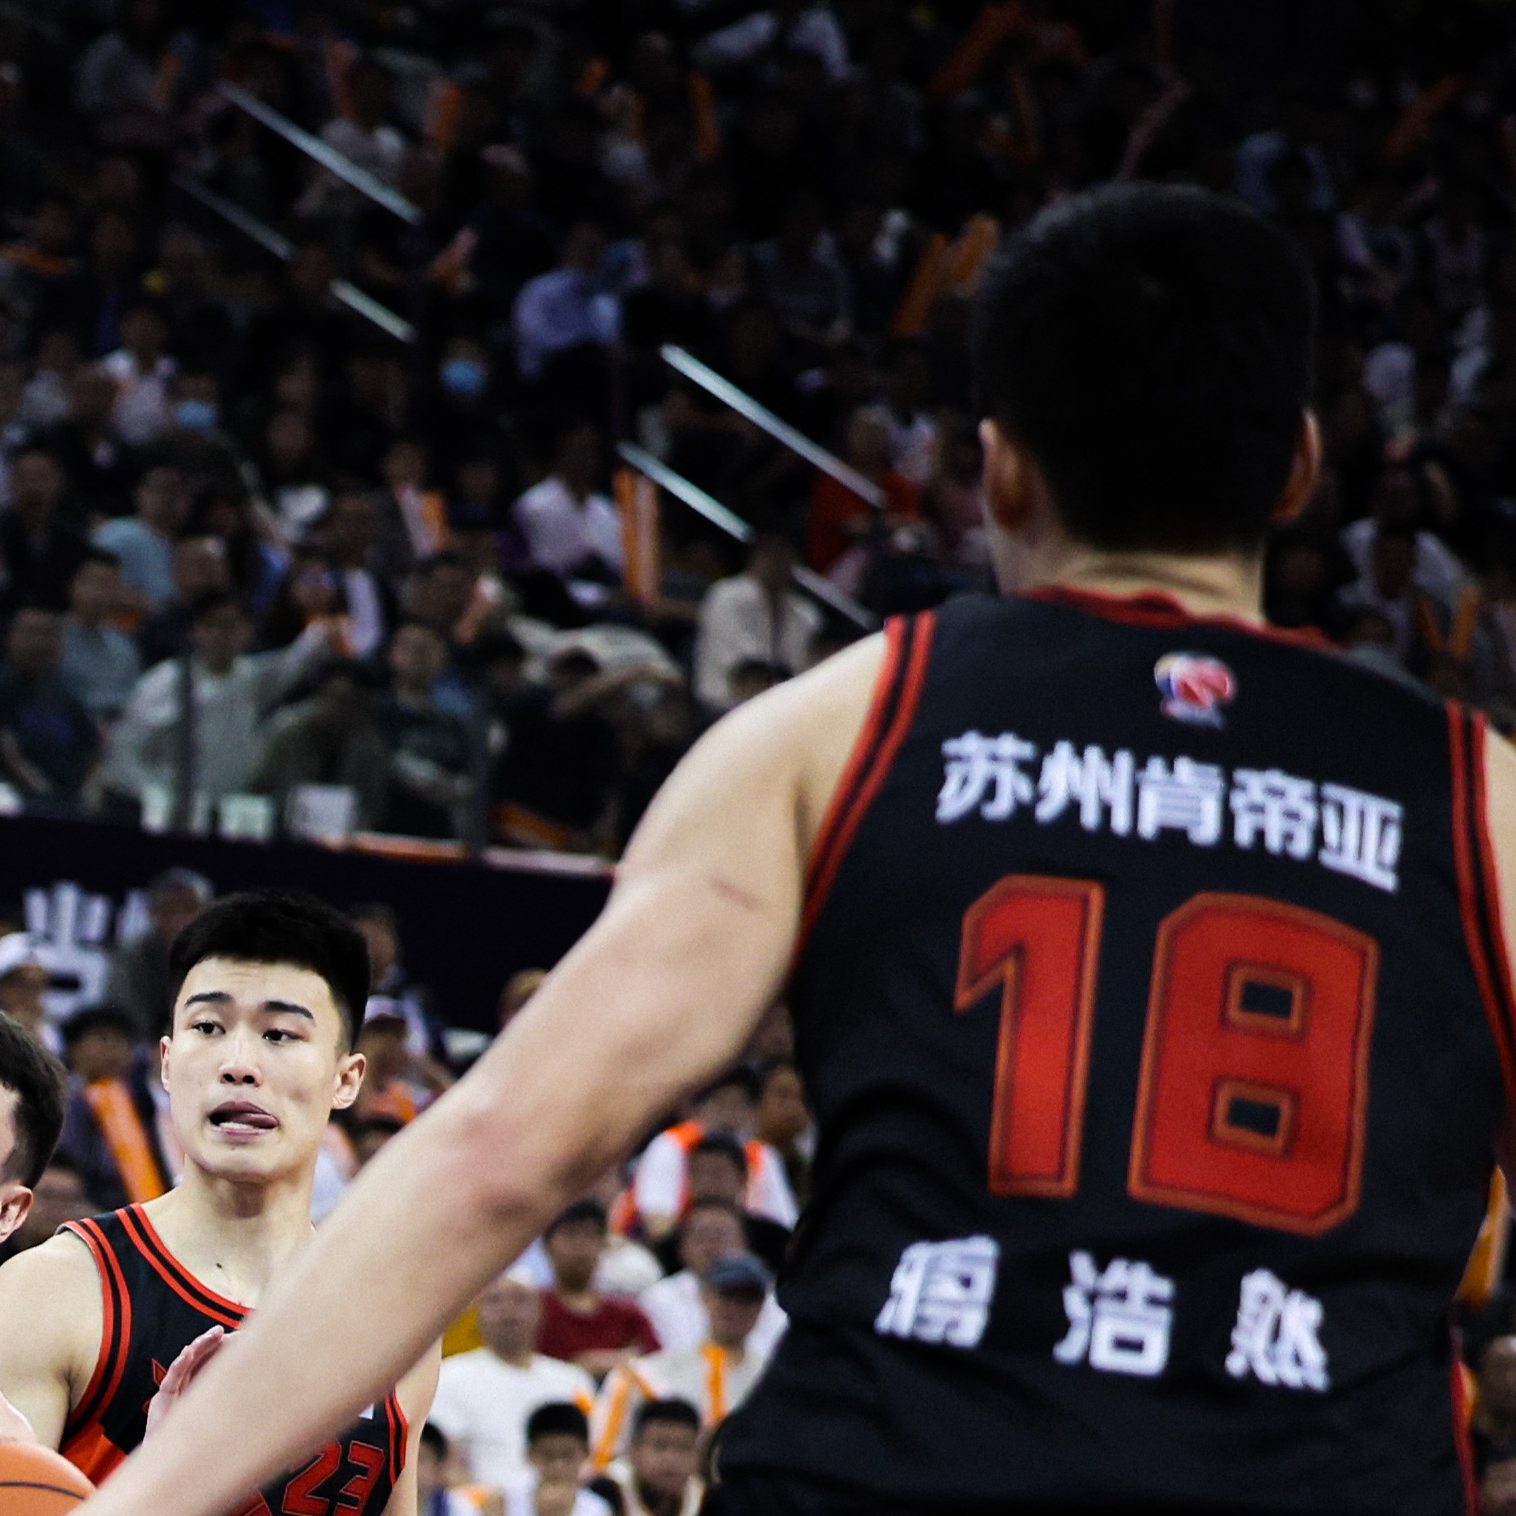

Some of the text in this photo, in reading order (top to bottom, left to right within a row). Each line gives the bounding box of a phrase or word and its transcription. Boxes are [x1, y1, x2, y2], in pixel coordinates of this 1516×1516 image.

[935, 729, 1404, 892] 苏州肯帝亚
[953, 872, 1380, 1237] 18
